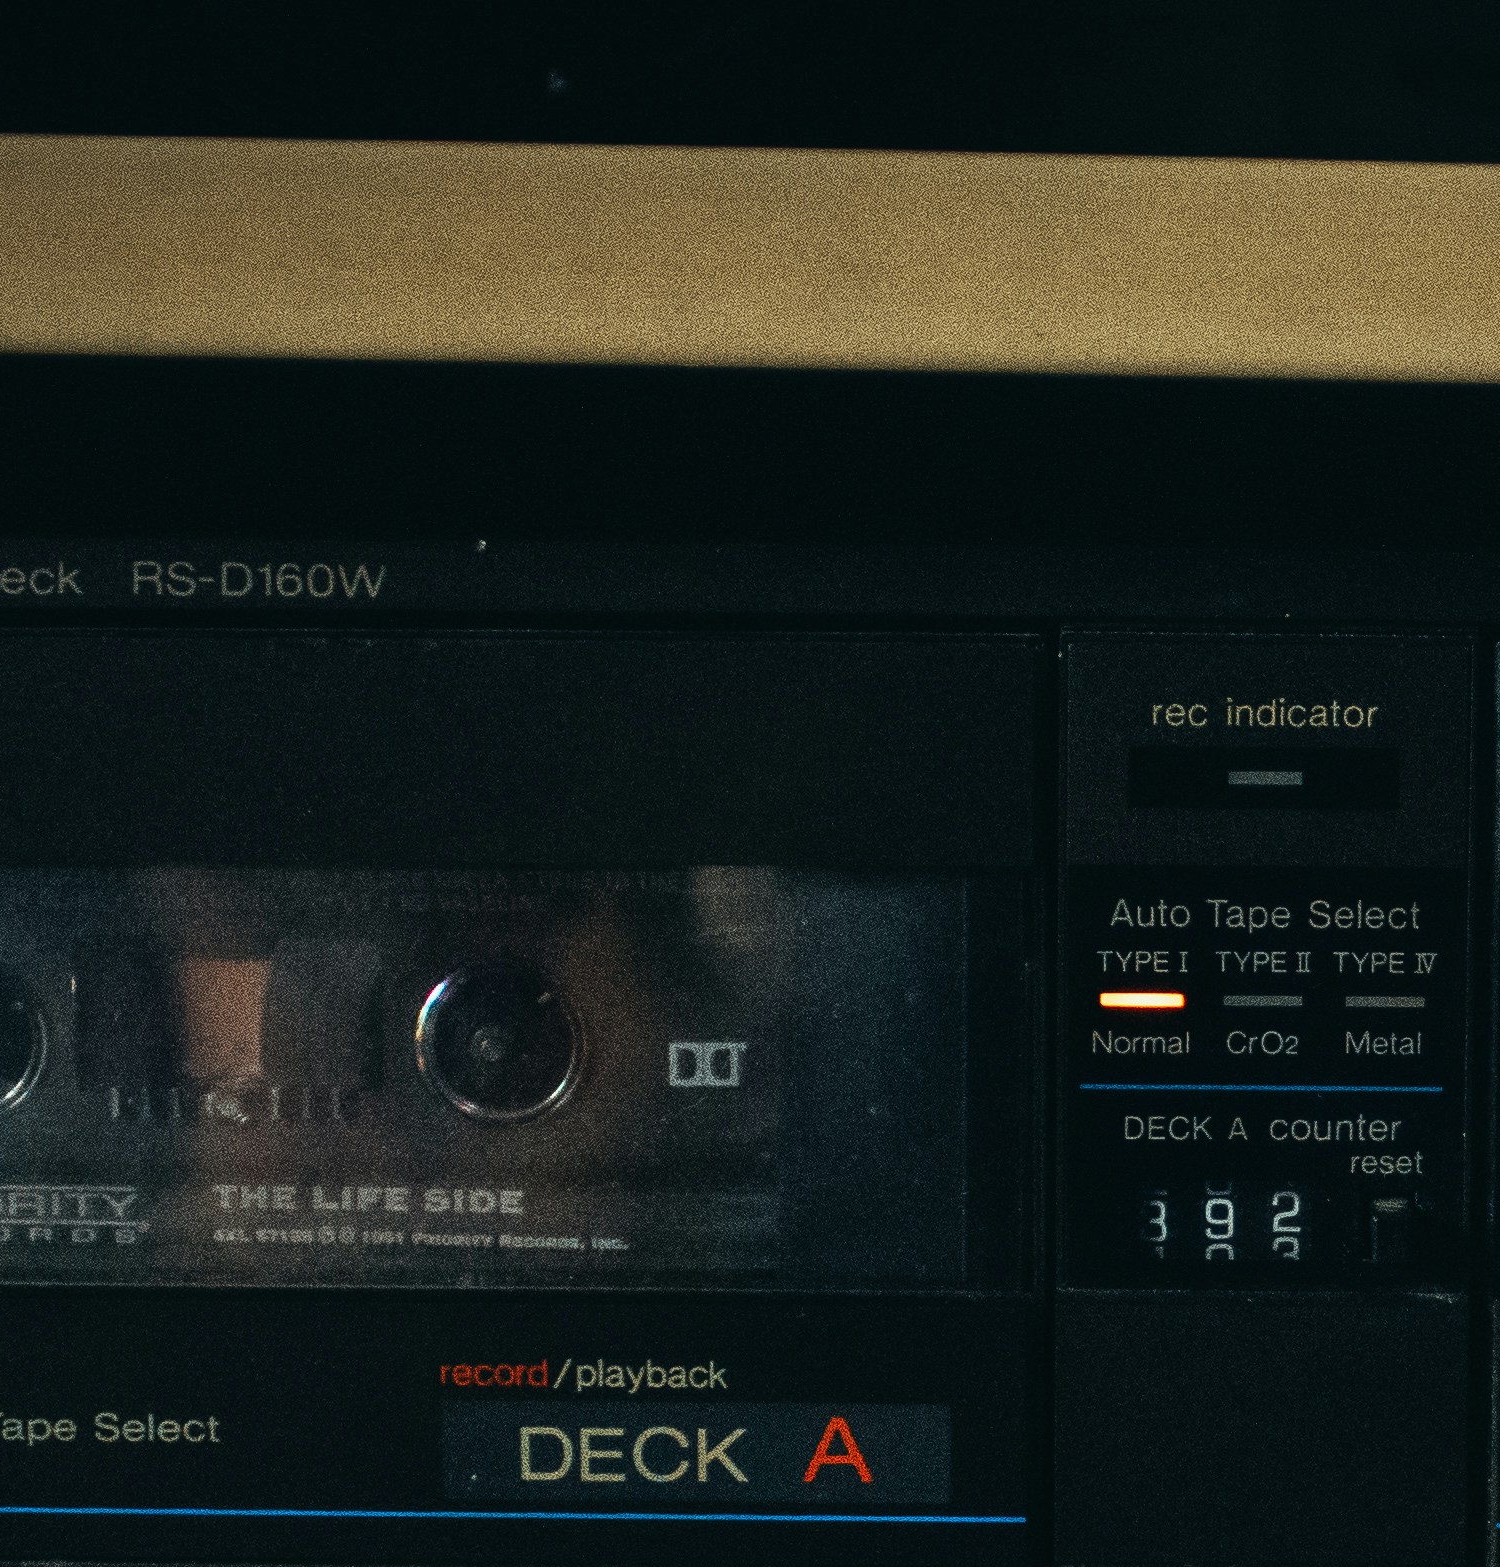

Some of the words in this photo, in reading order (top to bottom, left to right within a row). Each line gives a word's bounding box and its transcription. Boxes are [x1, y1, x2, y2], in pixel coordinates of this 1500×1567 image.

[133, 561, 385, 598] RS-D160W
[1152, 703, 1207, 727] rec
[1227, 697, 1378, 728] indicator
[1110, 898, 1191, 928] Auto
[1207, 898, 1291, 933] Tape
[1308, 899, 1419, 930] Select
[1098, 950, 1169, 974] TYPE
[1216, 950, 1286, 974] TYPE
[1333, 951, 1404, 974] TYPE
[1092, 1030, 1190, 1055] Normal
[1226, 1030, 1299, 1056] CrO2
[1345, 1031, 1422, 1055] Metal
[1124, 1115, 1212, 1141] DECK
[1228, 1116, 1248, 1140] A
[1269, 1114, 1401, 1142] counter
[1350, 1152, 1423, 1176] reset
[214, 1185, 294, 1209] THE
[314, 1187, 408, 1212] LIFE
[425, 1189, 523, 1214] SIDE
[440, 1359, 727, 1394] record/playback
[95, 1412, 219, 1442] Select
[520, 1426, 748, 1482] DECK
[804, 1417, 872, 1483] A
